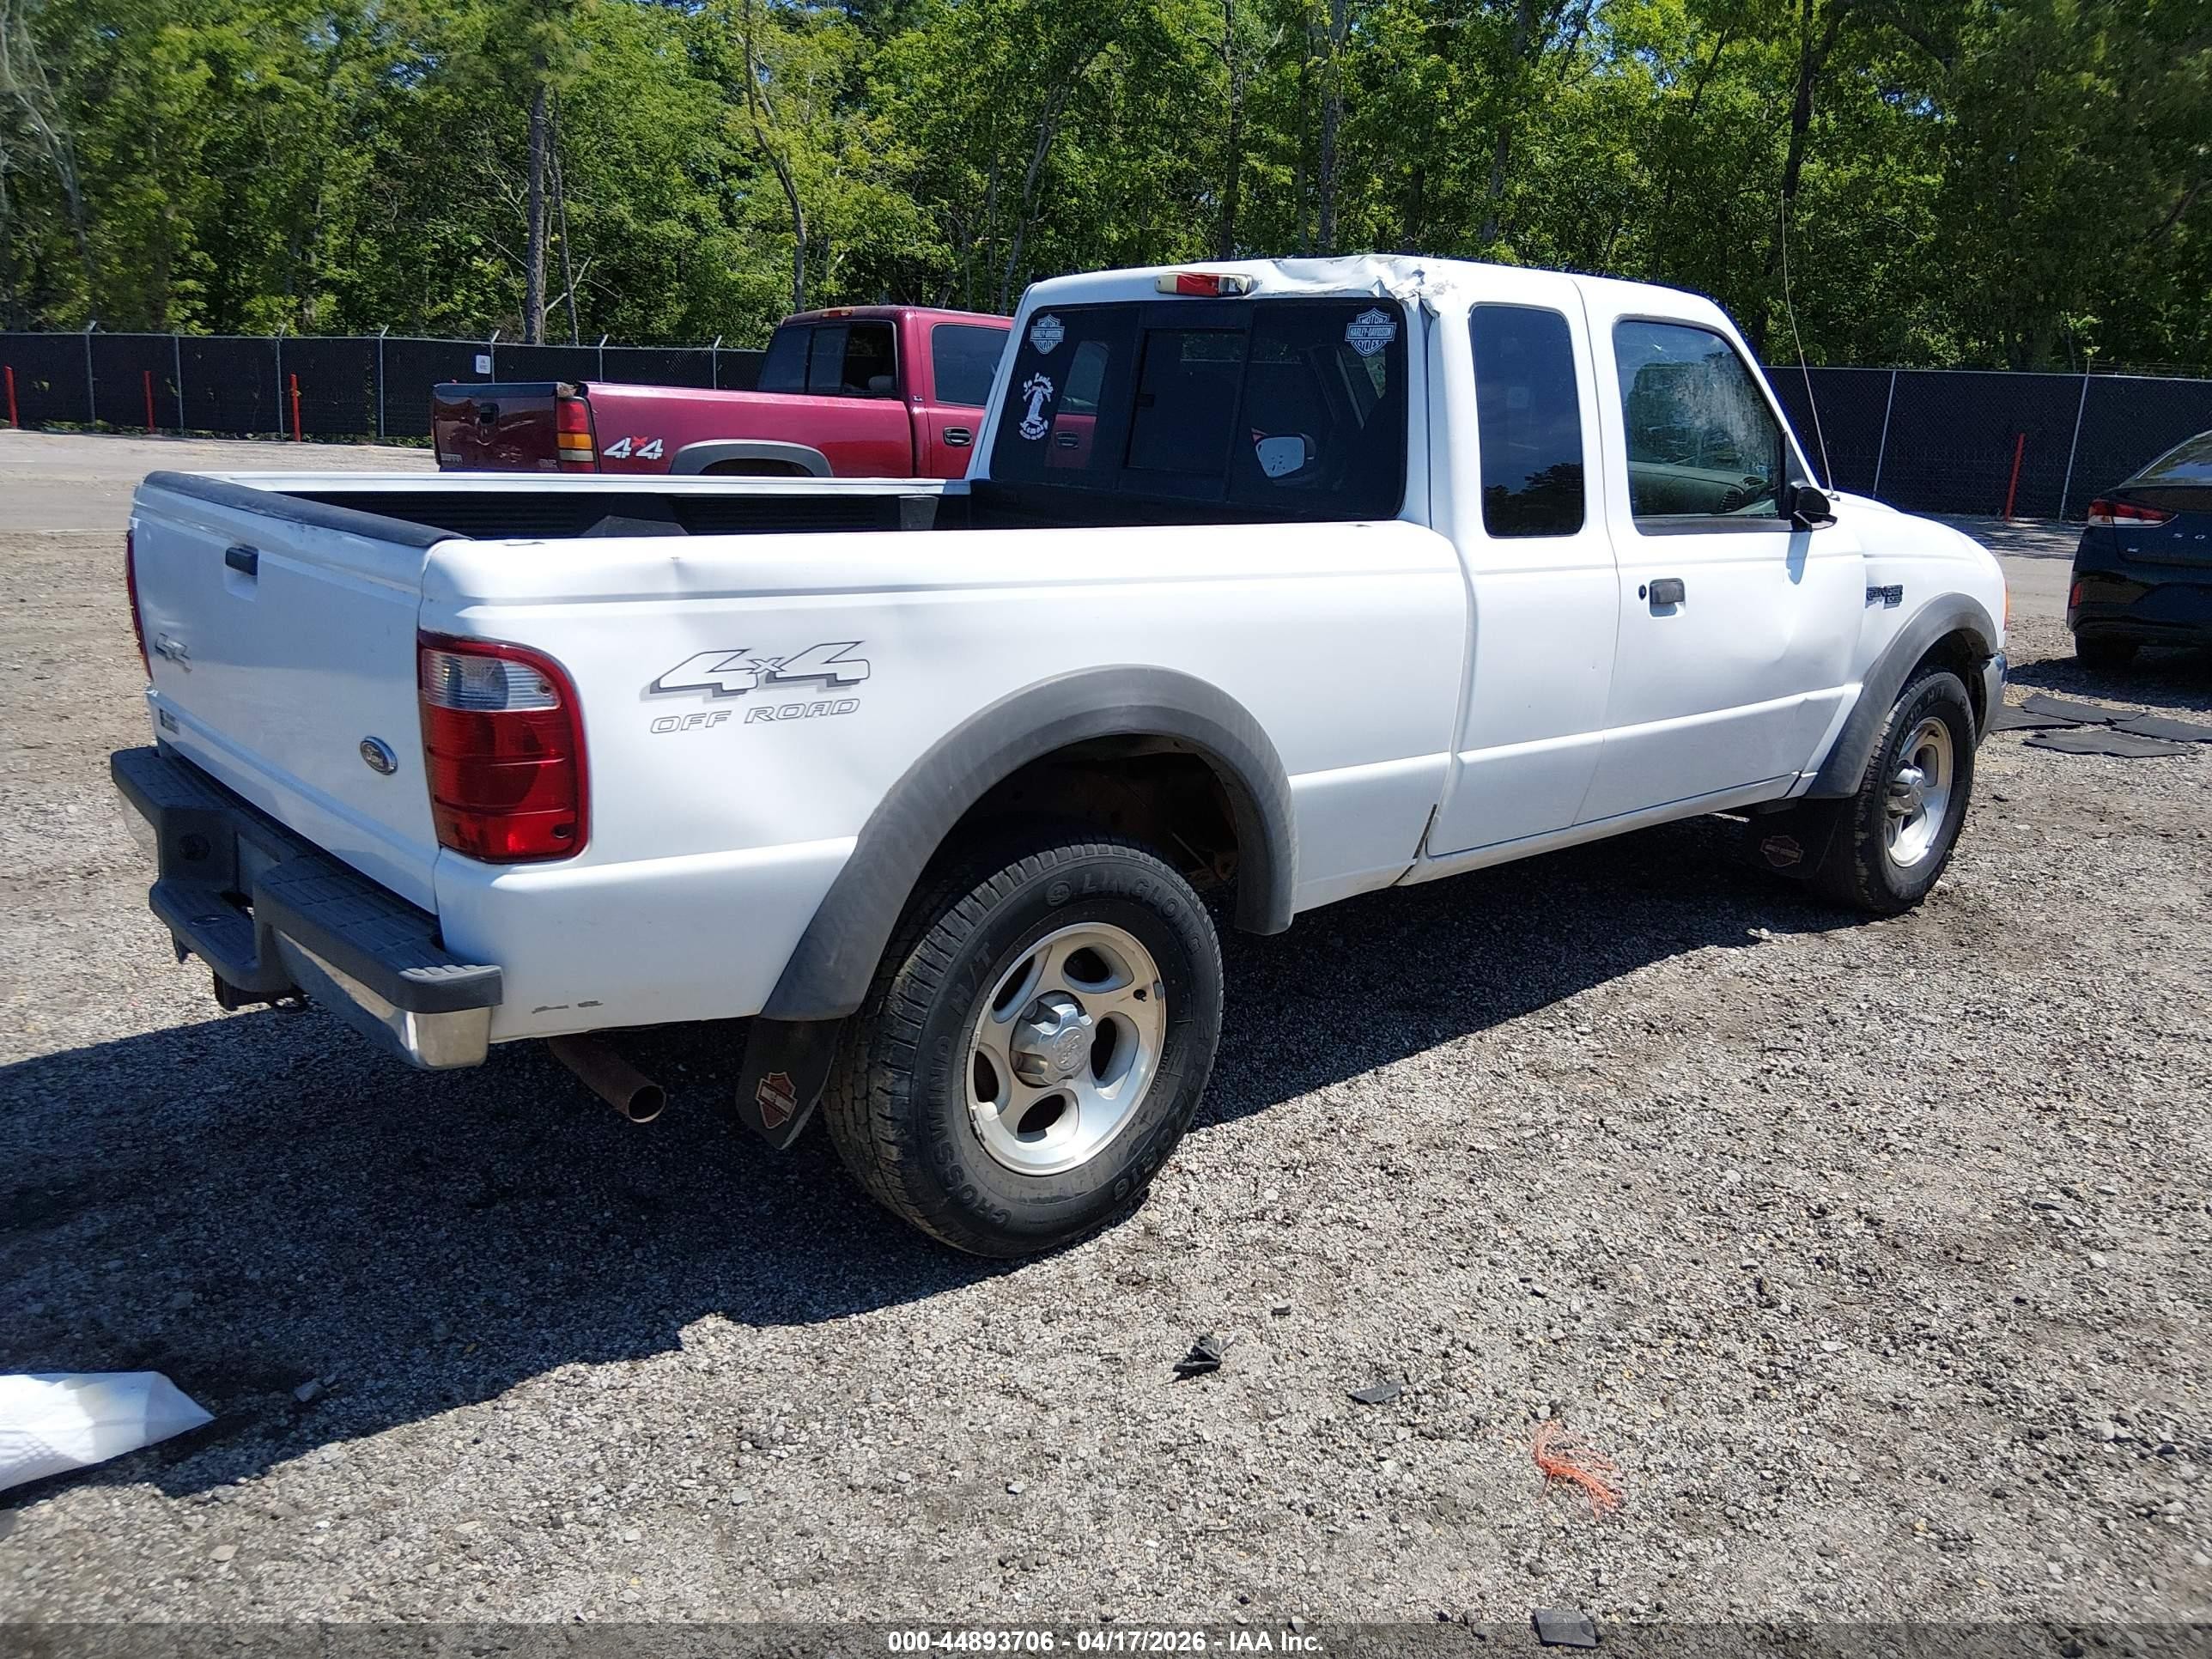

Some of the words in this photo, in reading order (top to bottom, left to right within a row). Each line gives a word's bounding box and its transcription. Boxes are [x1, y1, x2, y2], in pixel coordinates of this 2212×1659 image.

[1362, 315, 1384, 325] MOTOR
[1357, 340, 1380, 352] CYCLES
[639, 640, 870, 704] 4x4
[650, 710, 732, 733] OFF
[744, 698, 860, 724] ROAD
